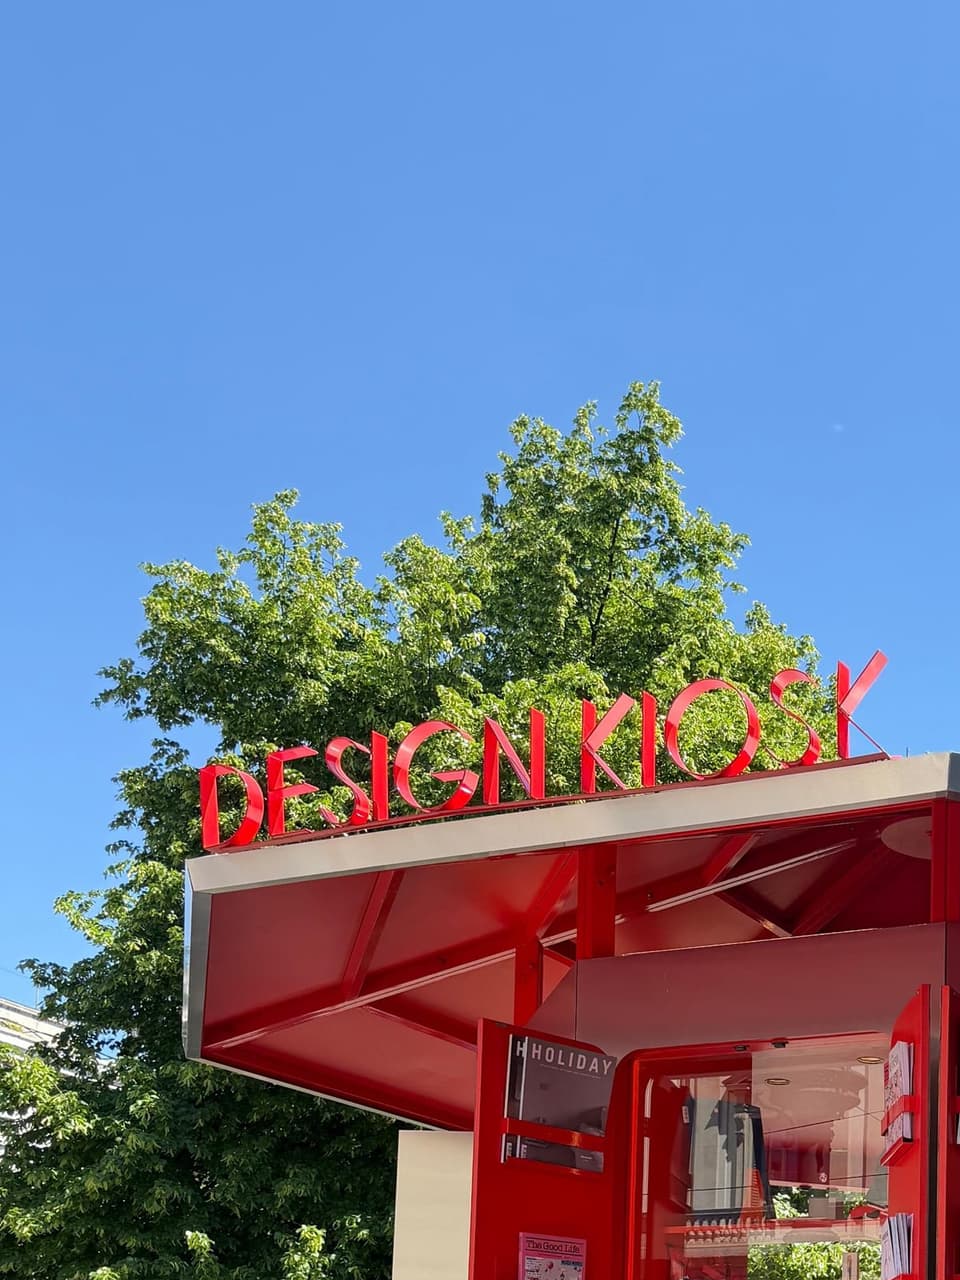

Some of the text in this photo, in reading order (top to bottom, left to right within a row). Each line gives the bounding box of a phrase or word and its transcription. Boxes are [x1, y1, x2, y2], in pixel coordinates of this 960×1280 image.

[199, 649, 892, 851] DESIGN KIOSK
[531, 1042, 613, 1075] HOLIDAY
[526, 1239, 542, 1249] The
[543, 1241, 563, 1252] Good
